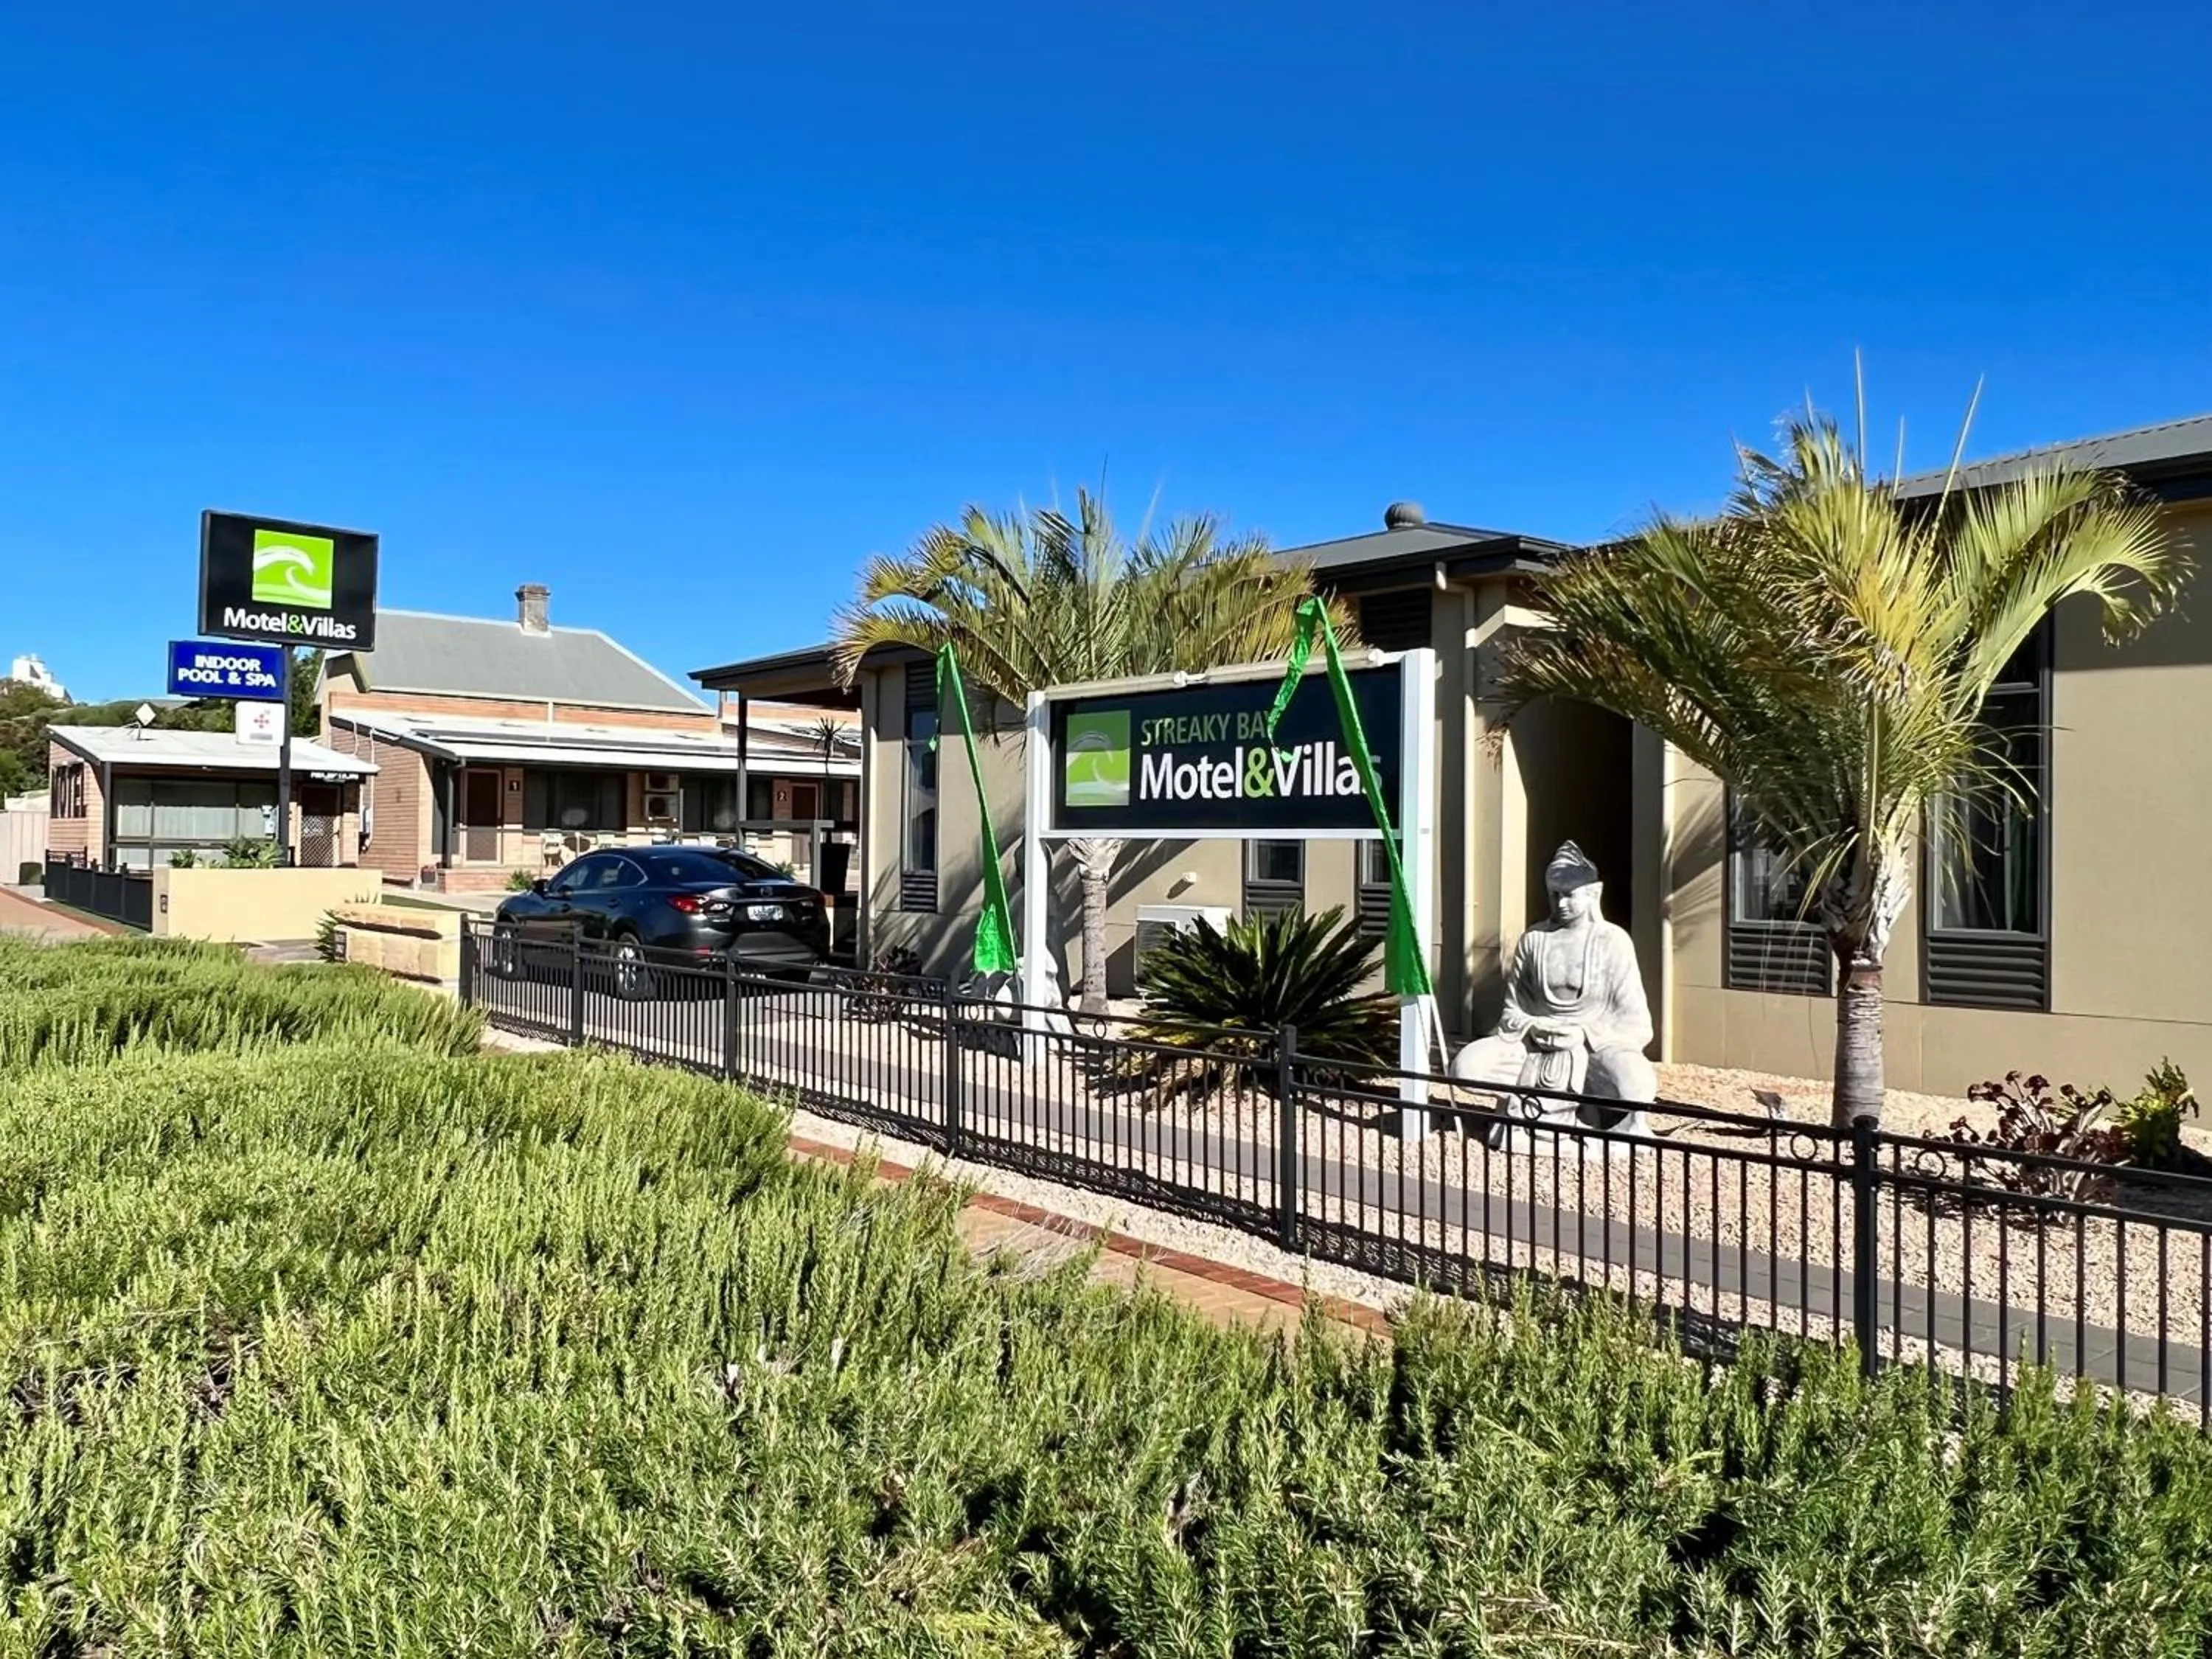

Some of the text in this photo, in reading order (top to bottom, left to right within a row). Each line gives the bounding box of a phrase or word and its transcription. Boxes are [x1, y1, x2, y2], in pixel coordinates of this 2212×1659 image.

[223, 607, 357, 639] Motel&Villas
[195, 655, 262, 672] INDOOR
[178, 667, 276, 688] POOL & SPA
[1141, 712, 1231, 746] STREAKY
